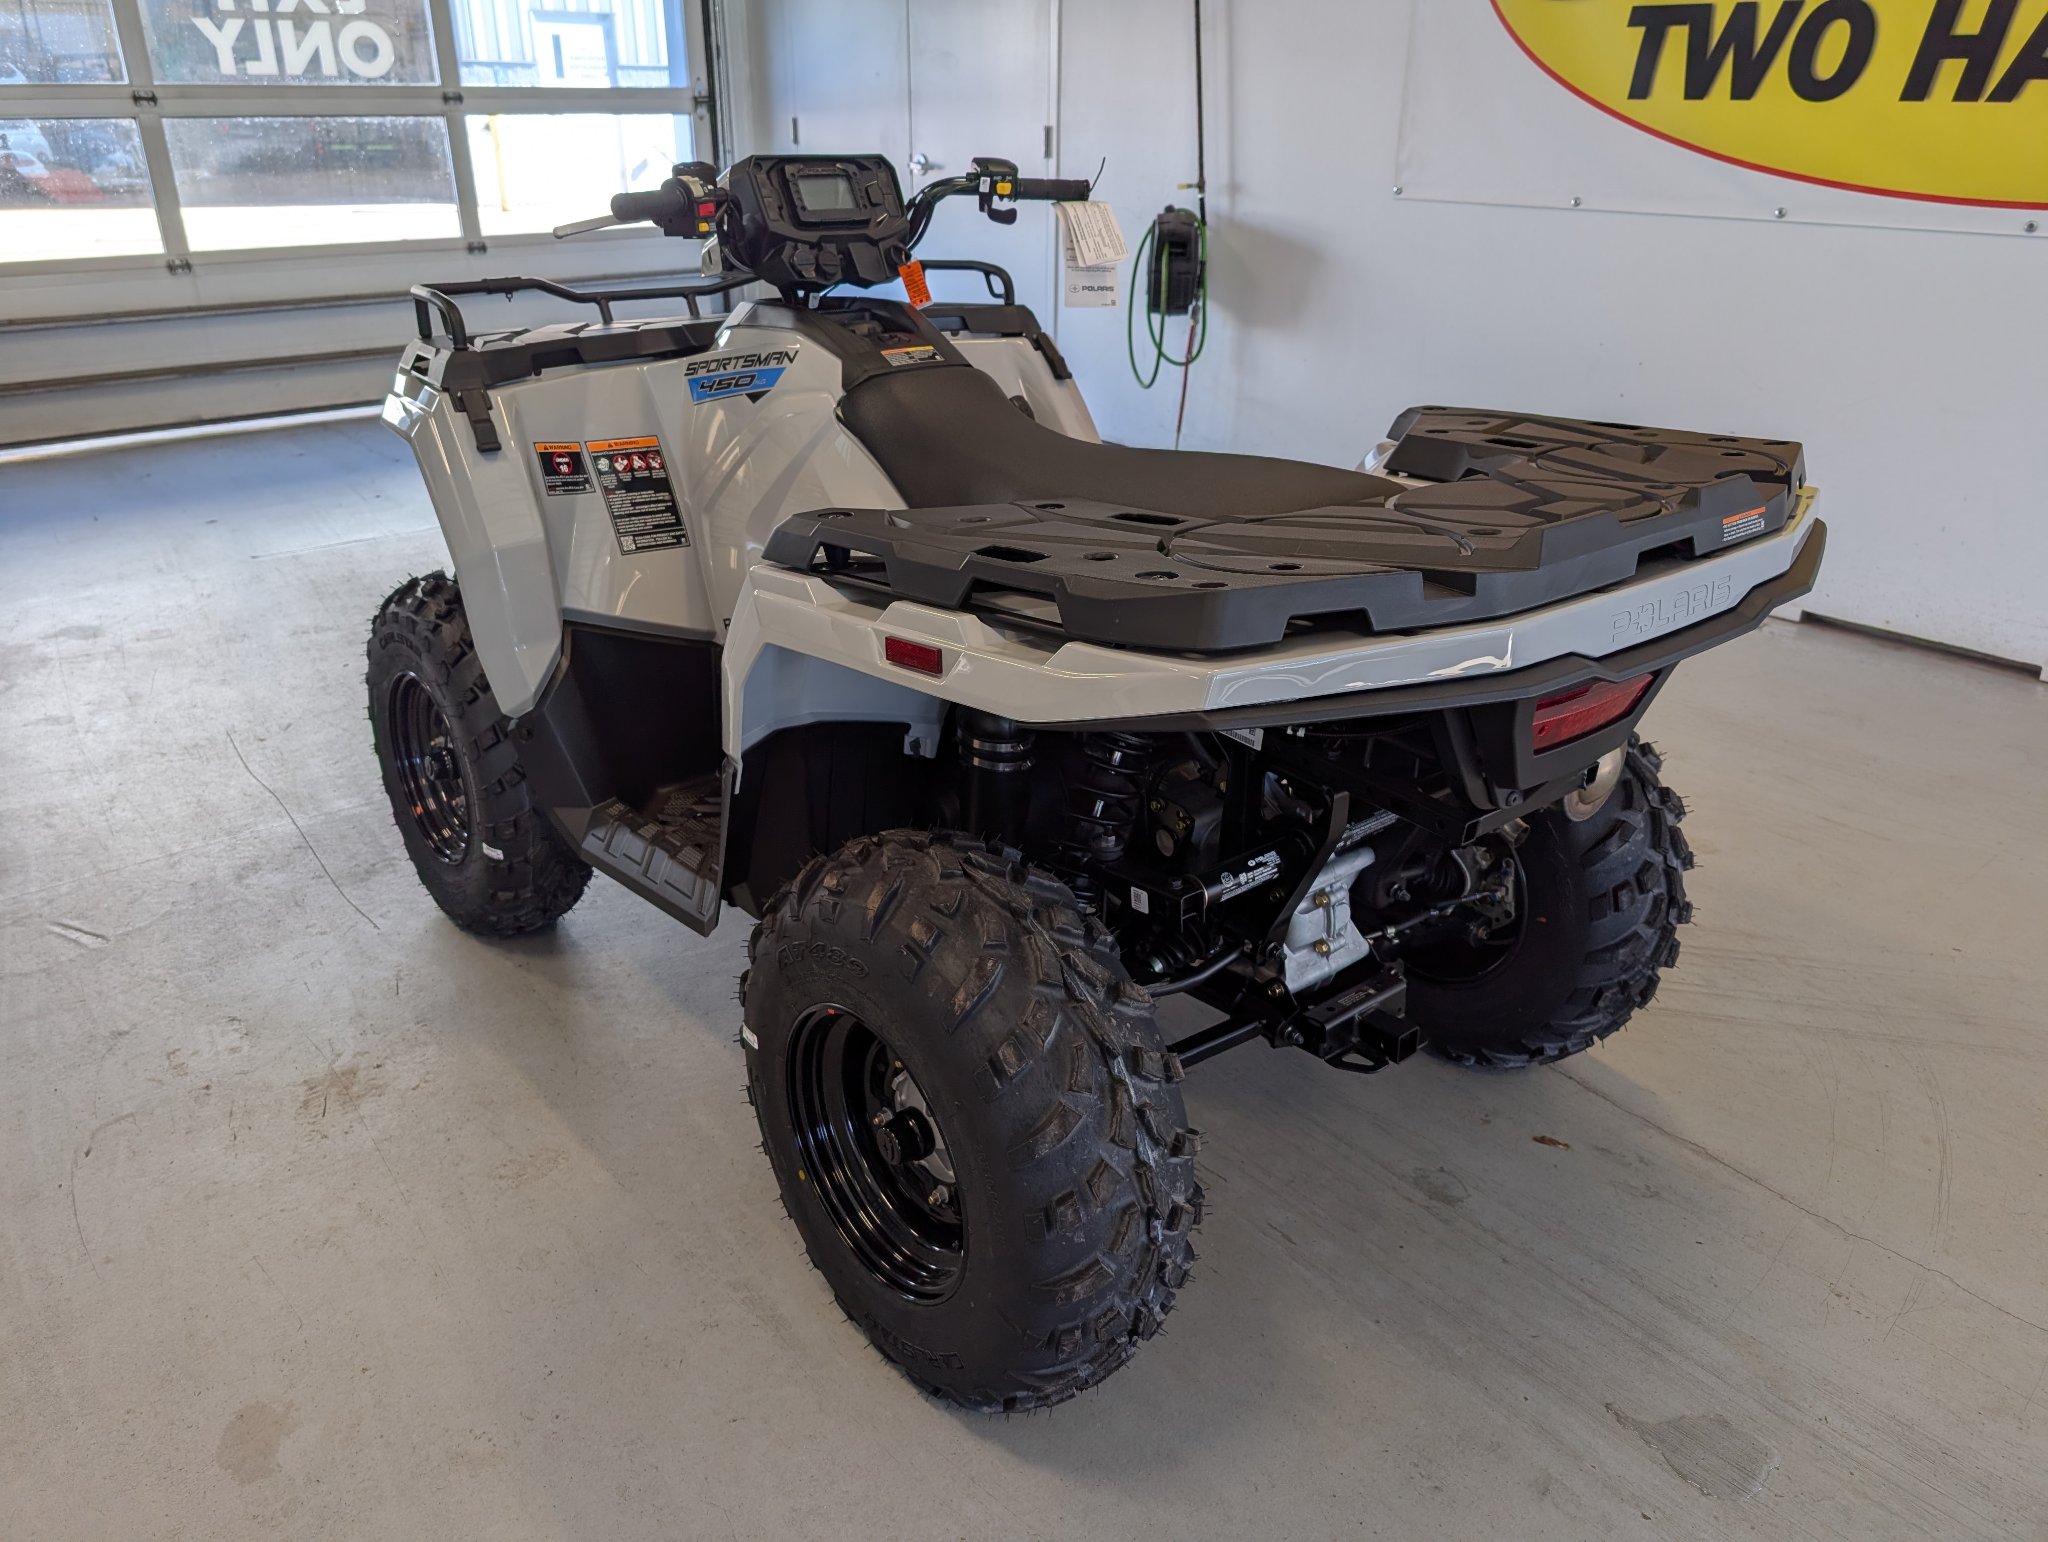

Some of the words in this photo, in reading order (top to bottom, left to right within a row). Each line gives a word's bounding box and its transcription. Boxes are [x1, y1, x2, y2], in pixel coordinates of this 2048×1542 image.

[1627, 0, 1876, 103] TWO
[684, 350, 799, 376] SPORTSMAN
[699, 373, 757, 393] 450
[614, 439, 640, 447] WARNING
[1611, 574, 1732, 643] POLARIS
